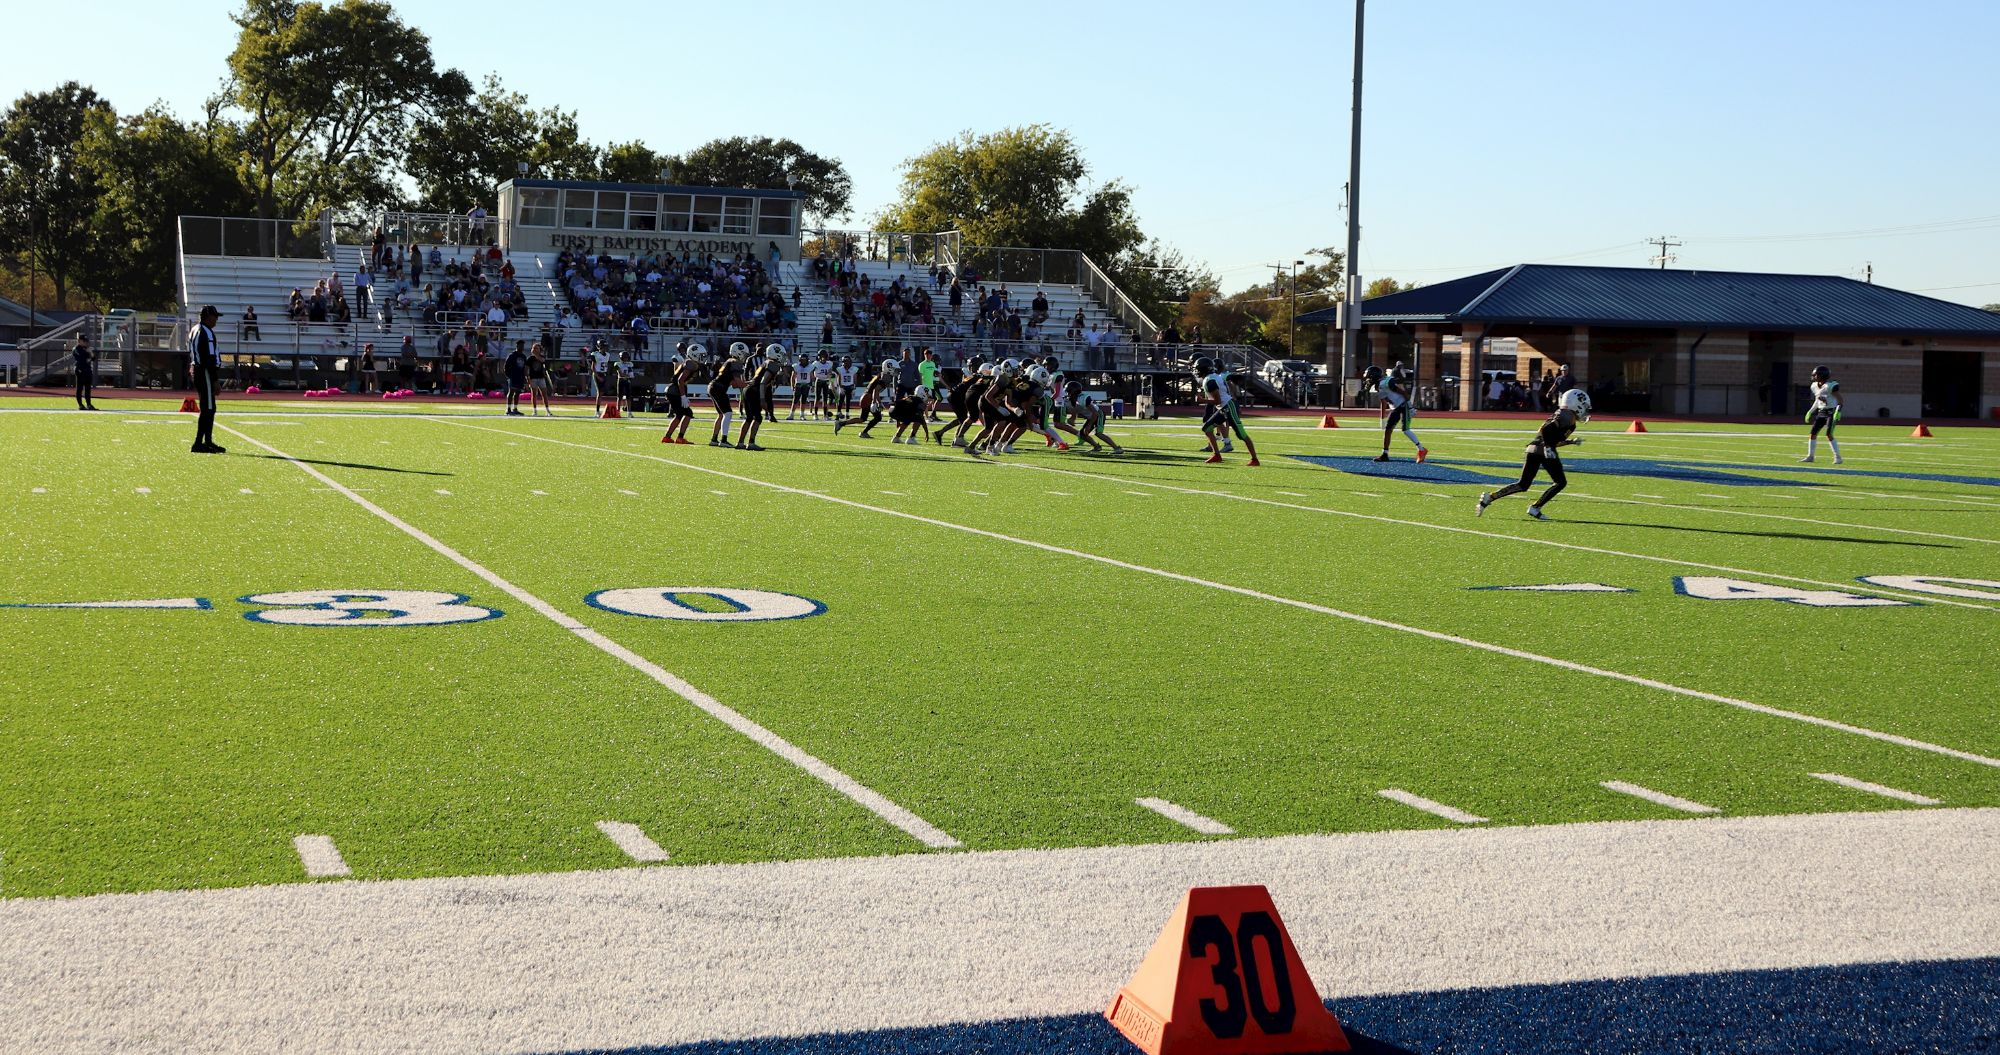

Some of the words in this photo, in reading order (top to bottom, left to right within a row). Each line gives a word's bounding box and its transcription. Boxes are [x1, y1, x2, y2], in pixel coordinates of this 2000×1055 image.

[551, 234, 598, 249] FIRST
[604, 236, 671, 250] BAPTIST
[676, 239, 755, 254] ACADEMY
[1188, 911, 1296, 1039] 30
